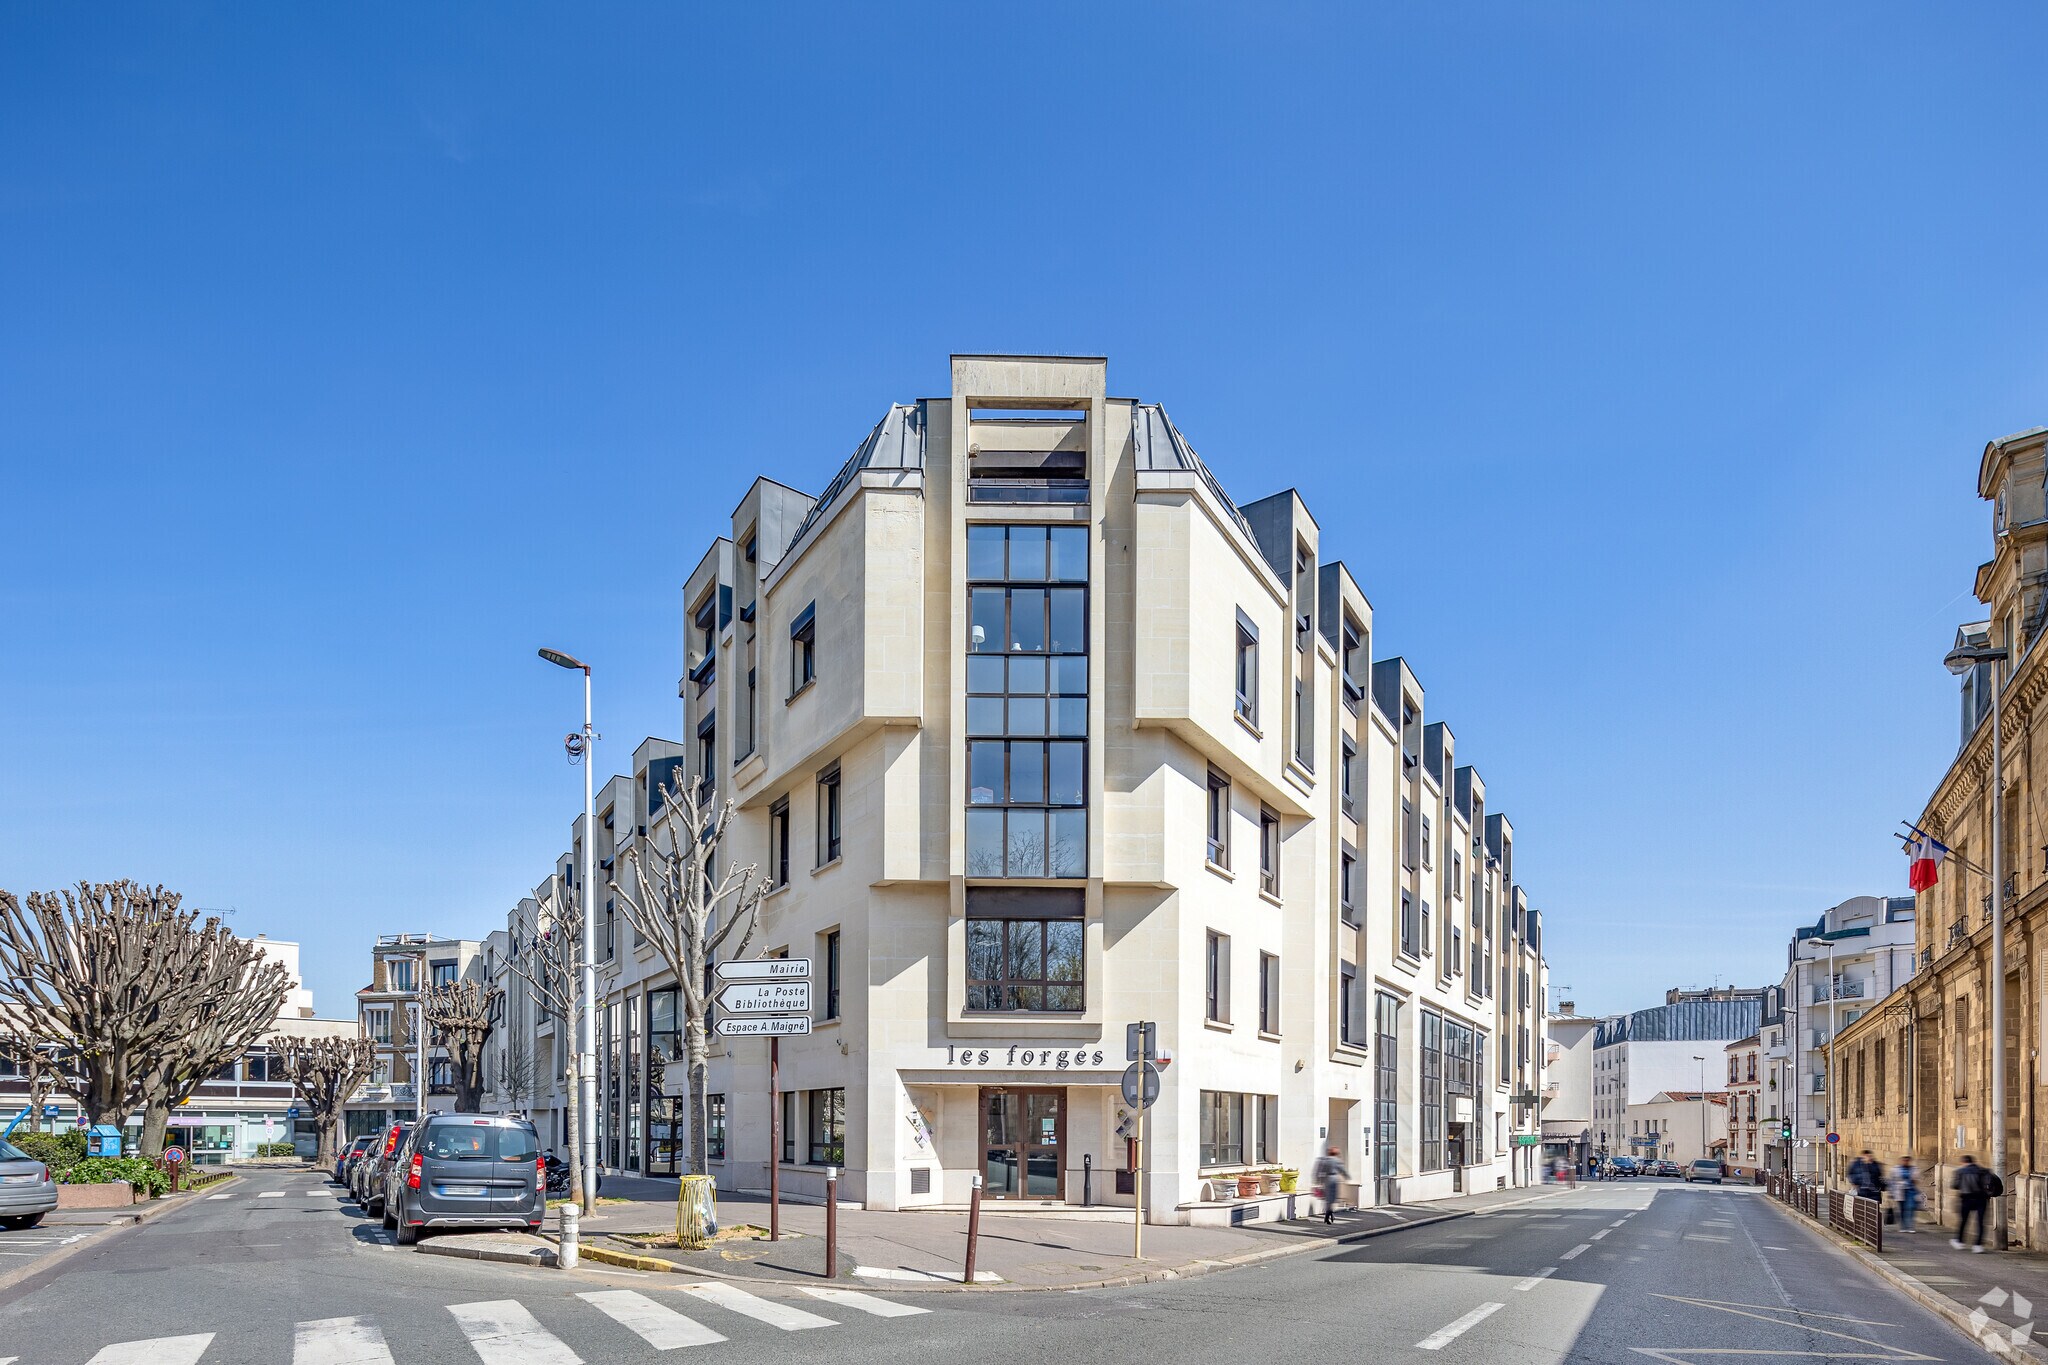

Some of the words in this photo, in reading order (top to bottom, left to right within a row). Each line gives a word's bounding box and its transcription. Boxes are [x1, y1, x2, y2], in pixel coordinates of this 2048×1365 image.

[770, 964, 805, 974] Mairie
[758, 988, 769, 997] La
[776, 987, 805, 996] Poste
[735, 999, 805, 1009] Bibliothèque
[726, 1022, 758, 1033] Espace
[947, 1044, 989, 1066] les
[1007, 1044, 1104, 1070] forges
